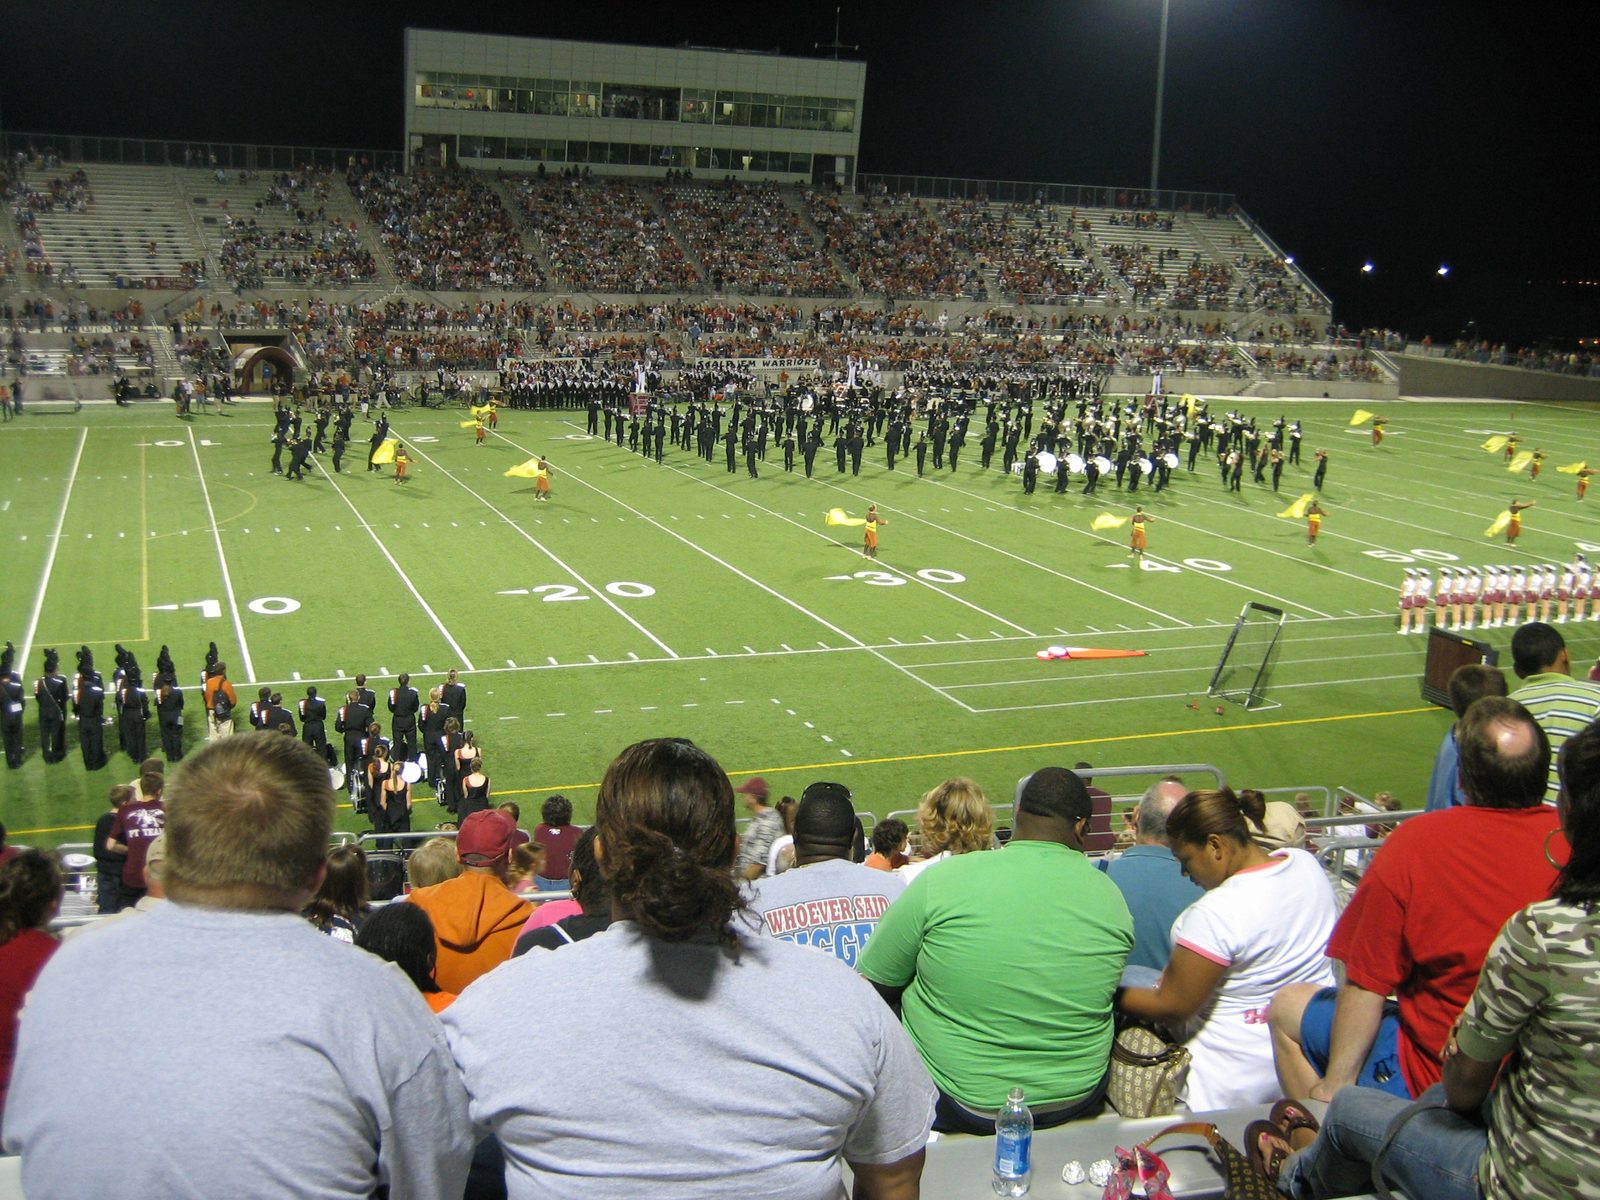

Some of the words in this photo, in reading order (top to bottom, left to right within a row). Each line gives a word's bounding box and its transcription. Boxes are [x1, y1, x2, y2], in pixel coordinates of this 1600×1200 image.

[762, 358, 818, 368] WARRIORS
[1361, 548, 1460, 563] 50
[1139, 557, 1233, 573] 40
[853, 568, 967, 586] 30
[532, 581, 656, 602] 20
[183, 597, 302, 618] 10
[764, 896, 853, 935] WHOEVER
[852, 895, 891, 920] SAID
